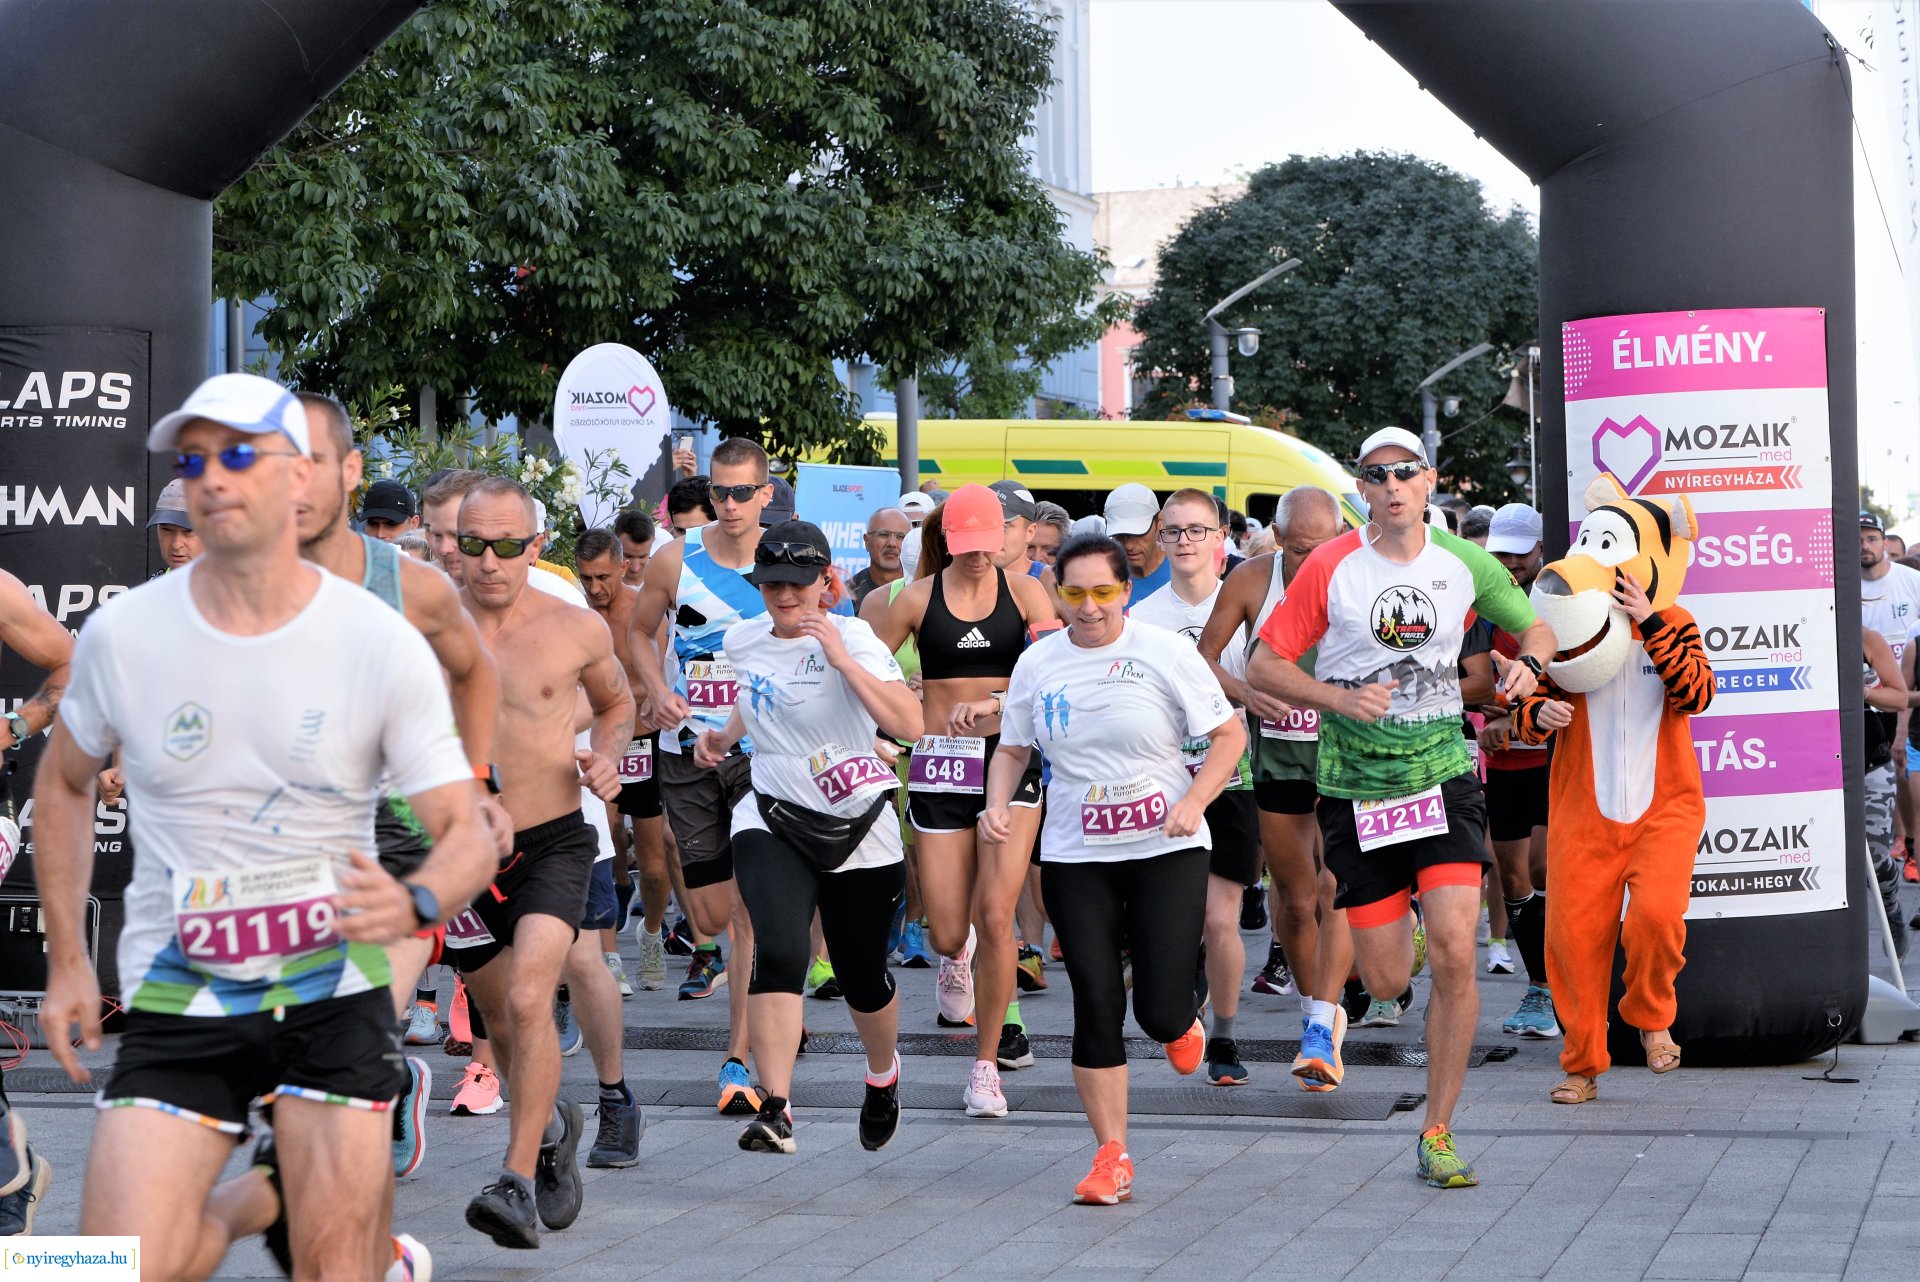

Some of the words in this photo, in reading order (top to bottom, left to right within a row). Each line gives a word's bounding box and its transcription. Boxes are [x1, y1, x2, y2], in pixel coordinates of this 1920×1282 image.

[1612, 324, 1773, 370] ÉLMÉNY.
[0, 371, 132, 410] APS
[53, 415, 127, 429] TIMING
[1664, 422, 1791, 452] MOZAIK
[1759, 448, 1792, 462] med
[1664, 468, 1775, 489] NYÍREGYHÁZA
[957, 638, 991, 649] adidas
[1770, 649, 1802, 664] med
[1126, 669, 1144, 679] TKM
[818, 758, 891, 799] 21220
[925, 758, 966, 781] 648
[1083, 796, 1166, 830] 21219
[1359, 798, 1443, 837] 21214
[1779, 849, 1812, 865] med
[182, 901, 336, 957] 21119
